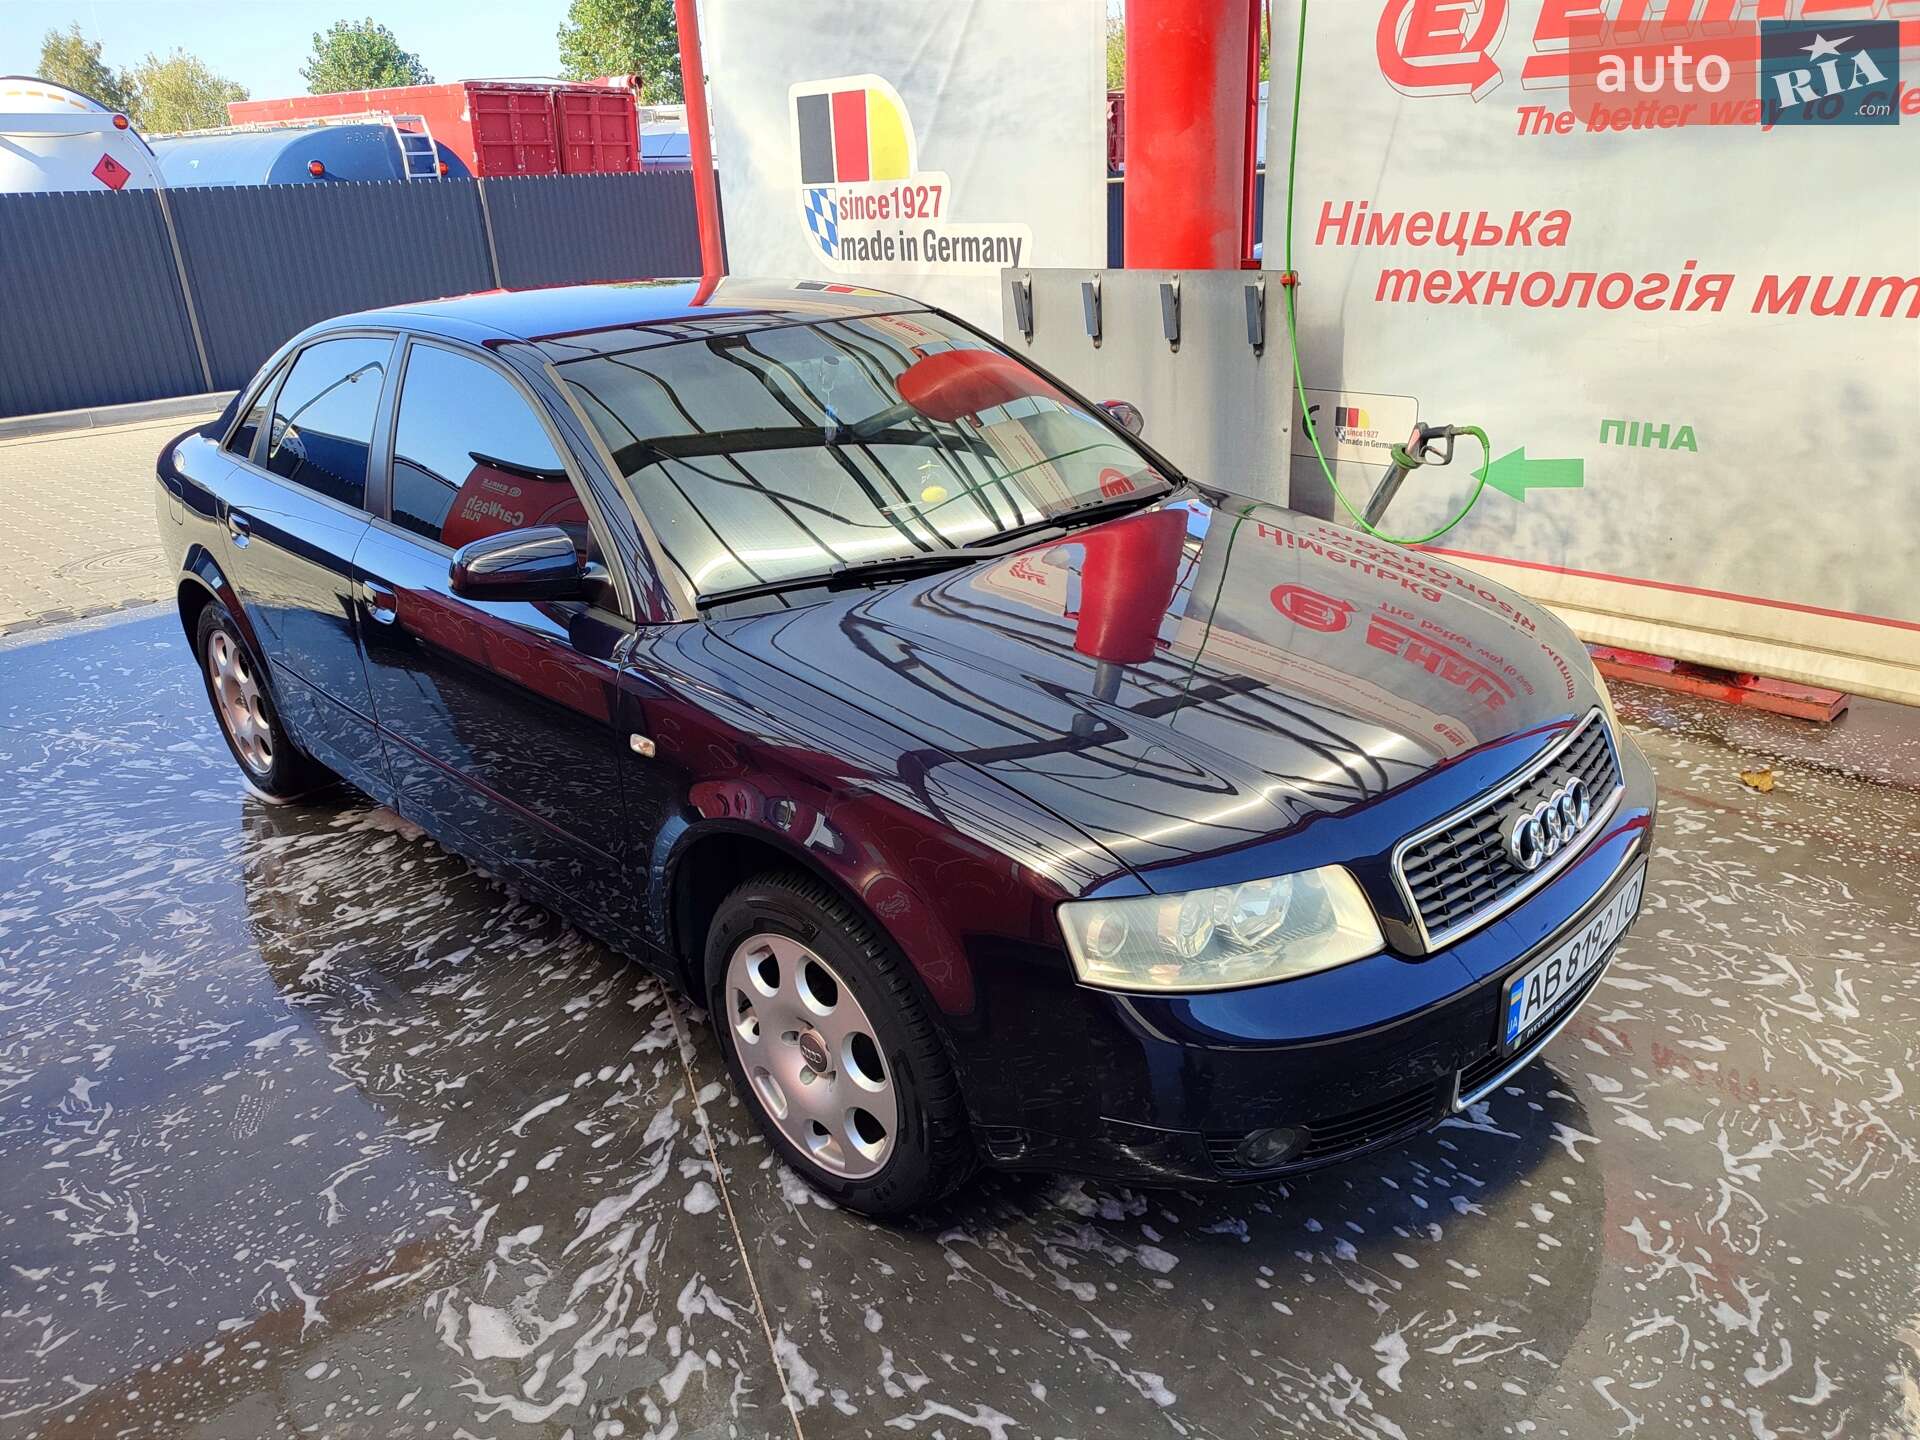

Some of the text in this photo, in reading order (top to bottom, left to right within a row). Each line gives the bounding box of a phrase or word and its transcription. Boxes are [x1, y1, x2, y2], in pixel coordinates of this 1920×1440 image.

[1516, 105, 1575, 135] The
[1587, 99, 1698, 134] better
[840, 185, 942, 220] since1927
[1314, 201, 1573, 255] Німецька
[841, 228, 1022, 267] made in Germany
[1375, 261, 1920, 319] технологія мит
[1345, 438, 1393, 449] made in Germa
[1599, 418, 1698, 452] ПІНА
[1524, 958, 1562, 1021] AB
[1565, 908, 1613, 983] 8192
[1507, 1016, 1518, 1034] UA
